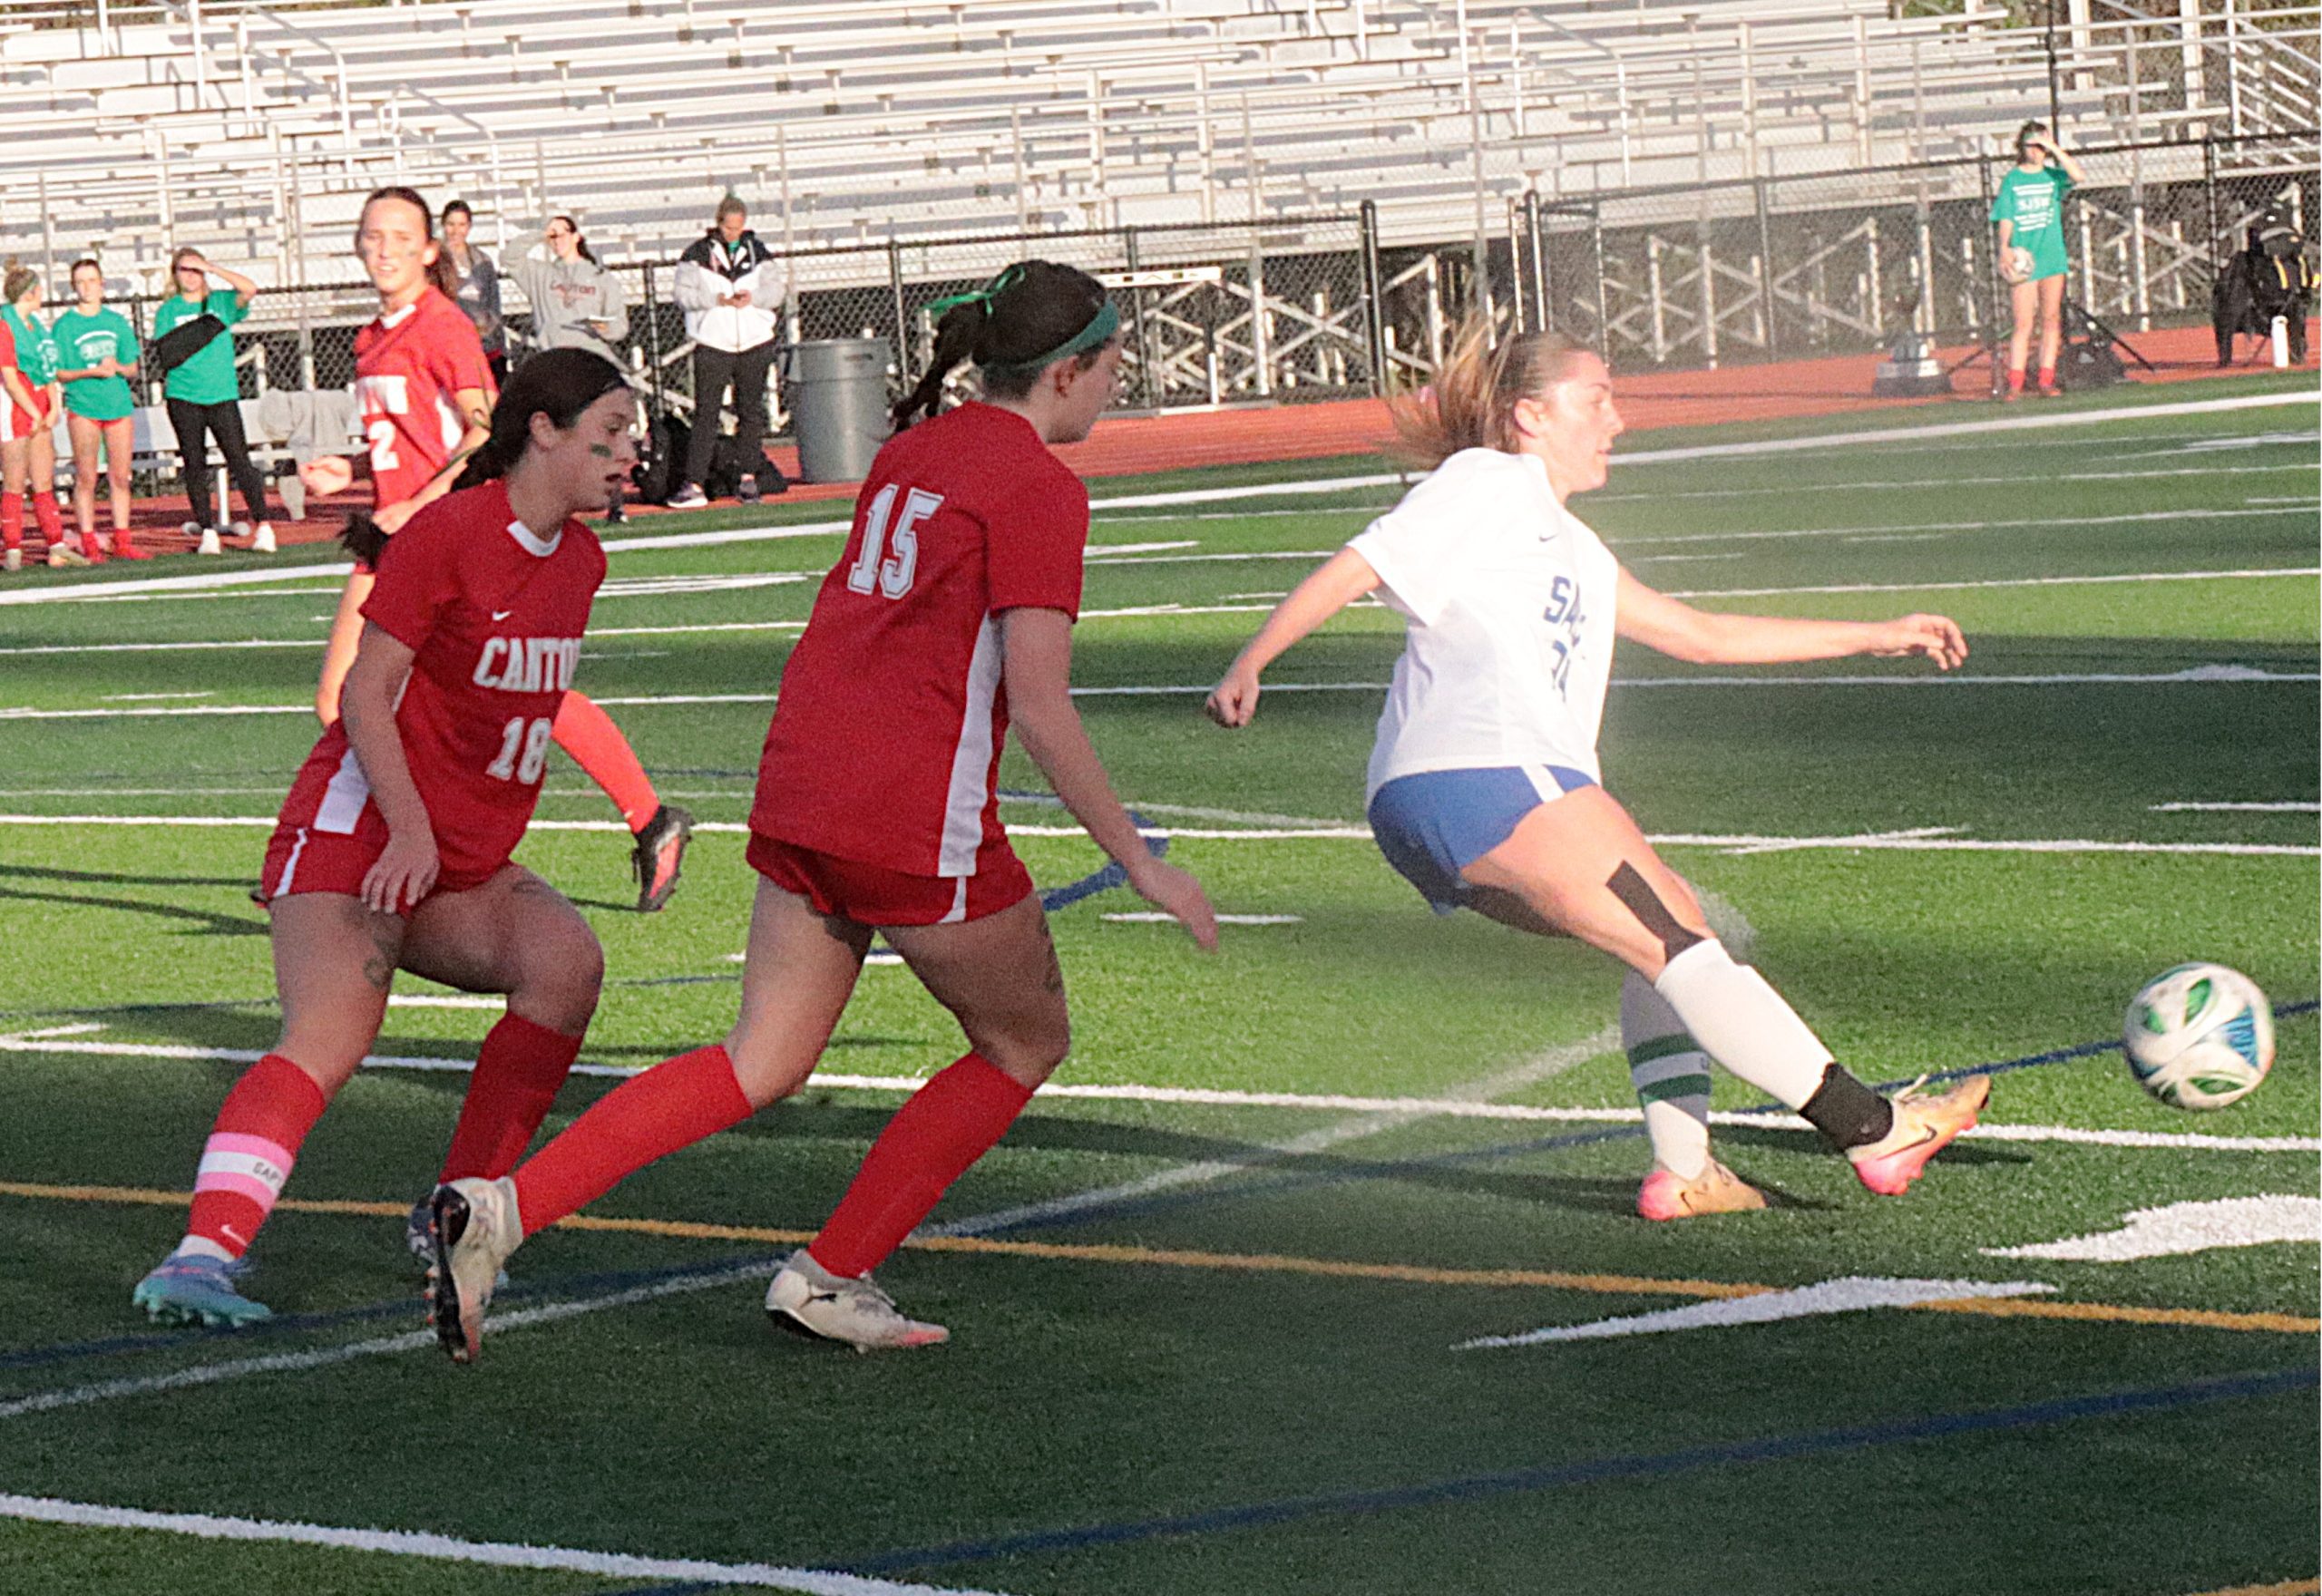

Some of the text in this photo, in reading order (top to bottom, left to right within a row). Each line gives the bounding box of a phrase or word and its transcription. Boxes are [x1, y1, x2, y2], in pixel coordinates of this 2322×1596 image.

[847, 483, 944, 600] 15
[473, 637, 583, 693] CANTO
[485, 716, 551, 784] 18
